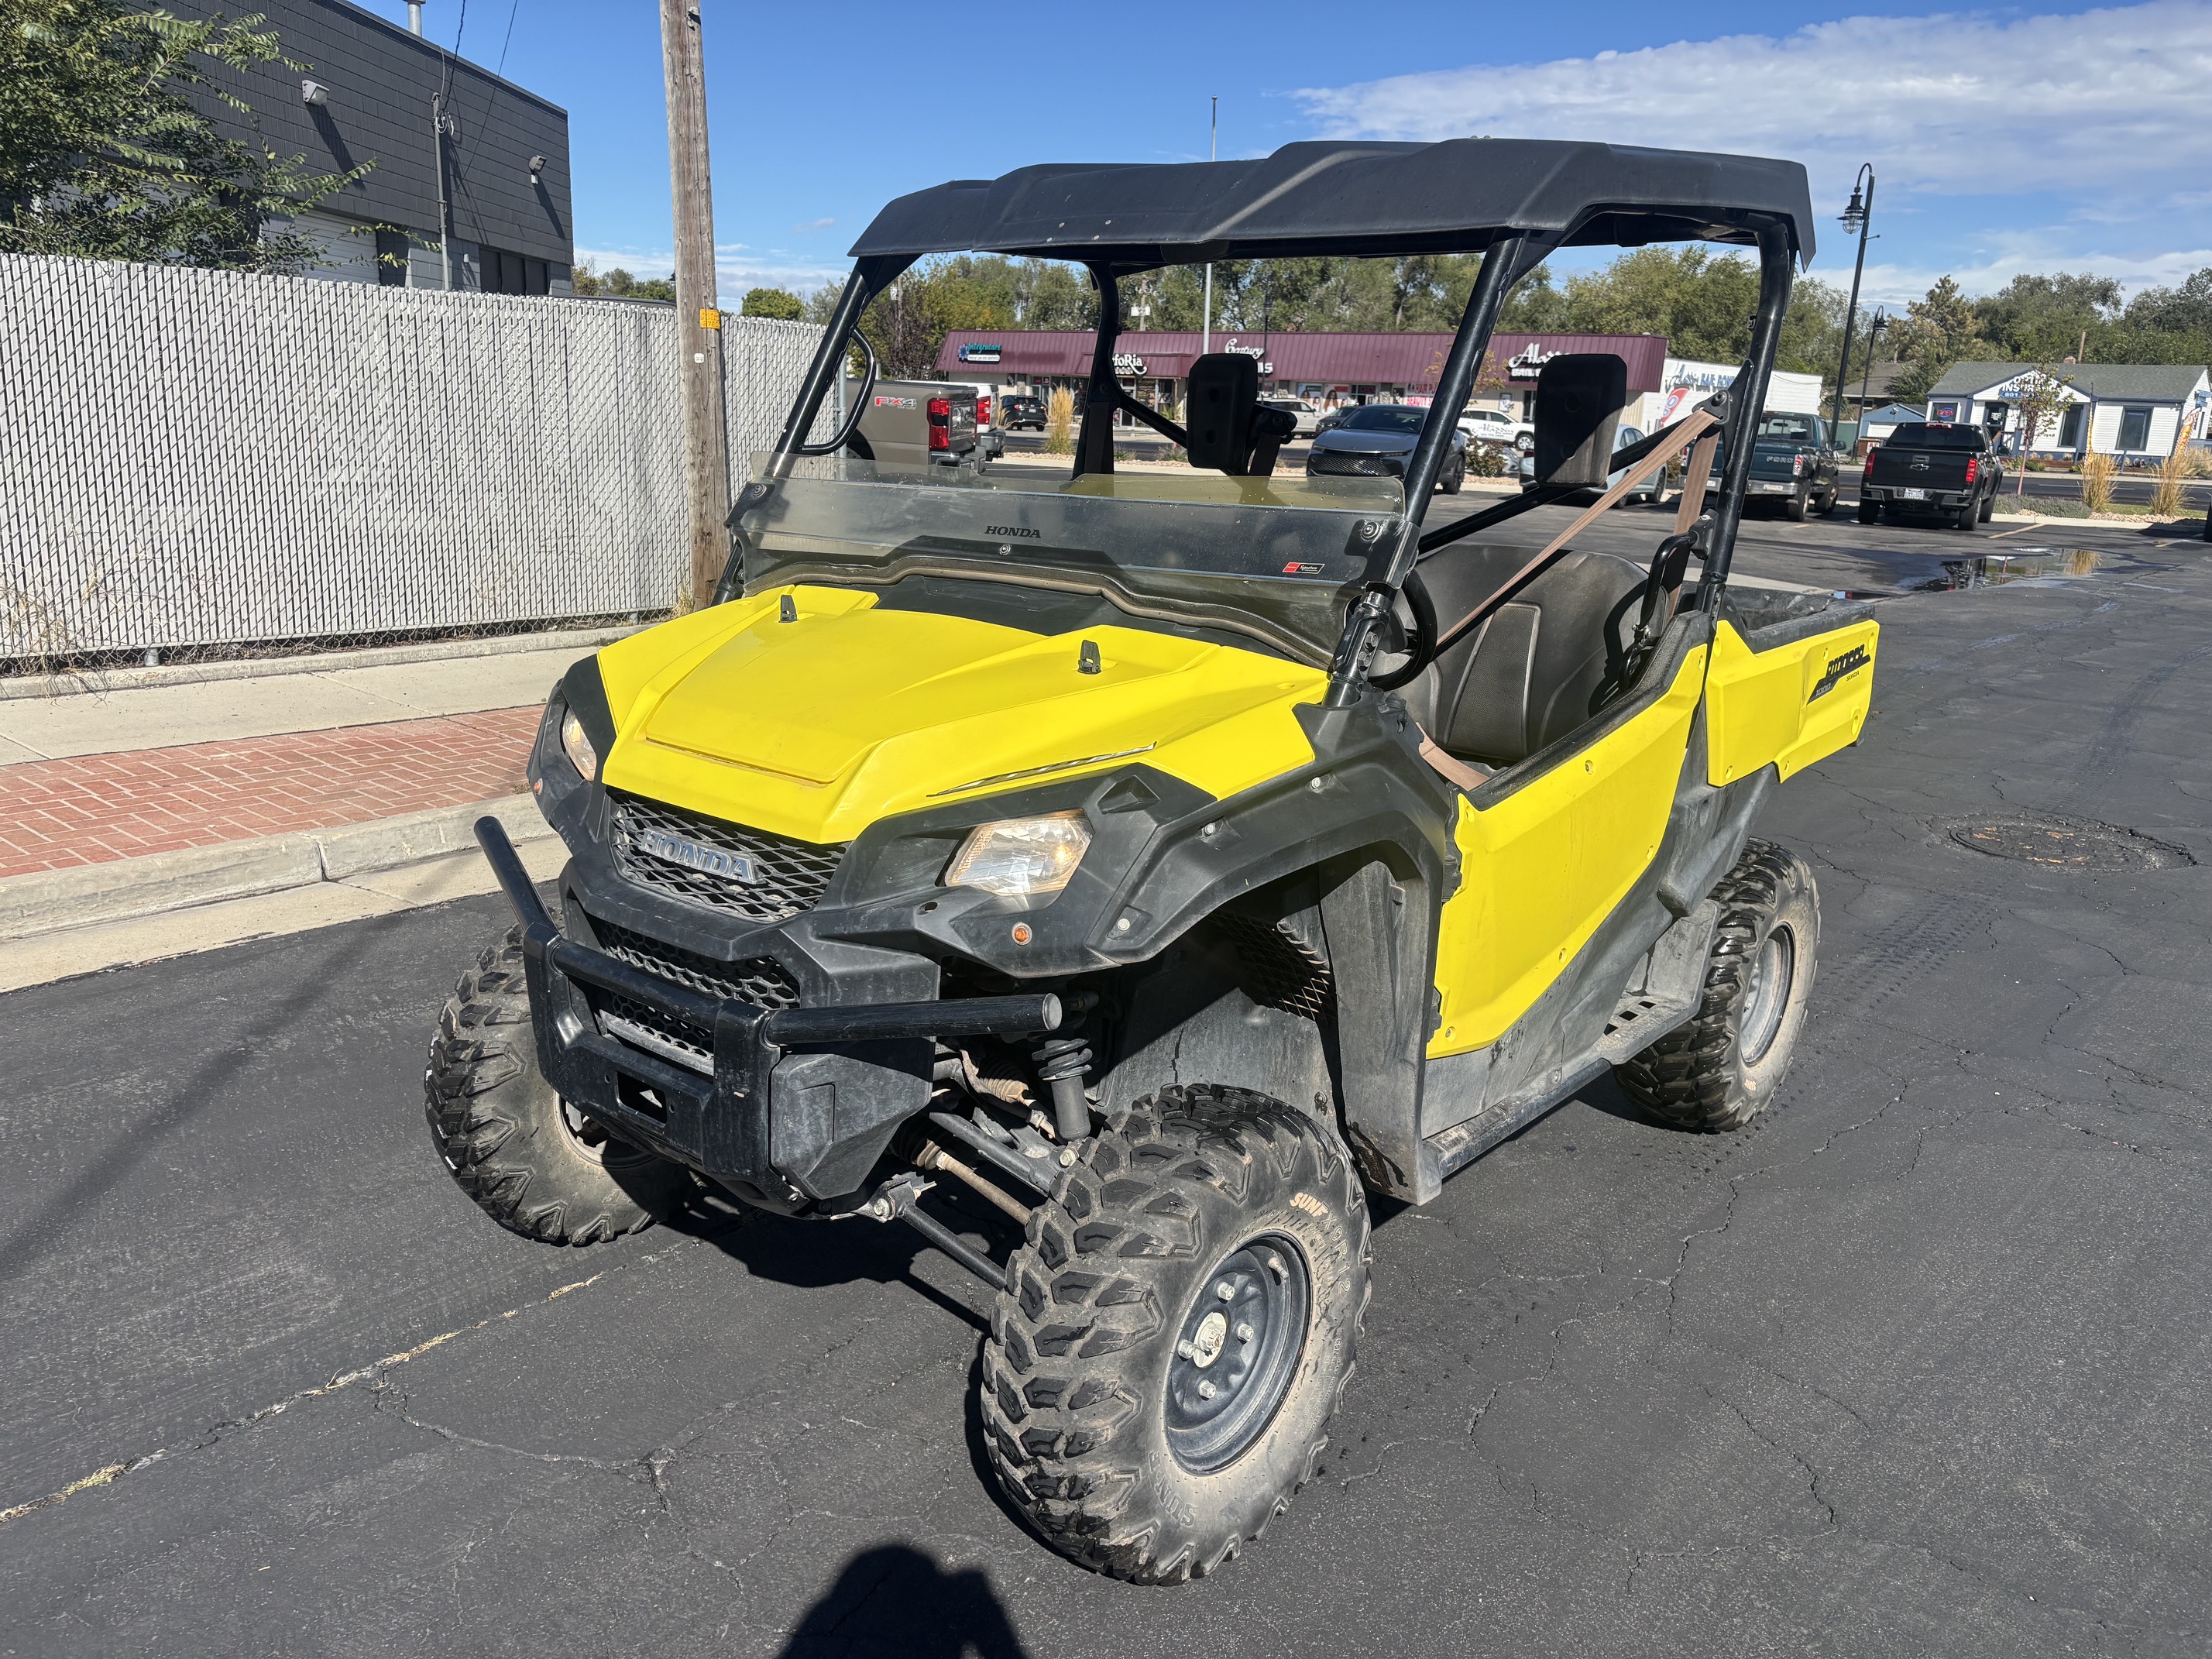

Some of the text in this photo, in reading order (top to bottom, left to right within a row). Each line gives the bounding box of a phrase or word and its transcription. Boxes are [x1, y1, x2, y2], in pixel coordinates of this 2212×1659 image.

[874, 396, 916, 407] FX4
[1662, 394, 1679, 417] OP
[1766, 455, 1794, 464] FORD
[984, 525, 1042, 539] HONDA
[1825, 644, 1871, 679] PIONEER
[1815, 683, 1832, 696] 1000
[638, 827, 758, 884] HONDA
